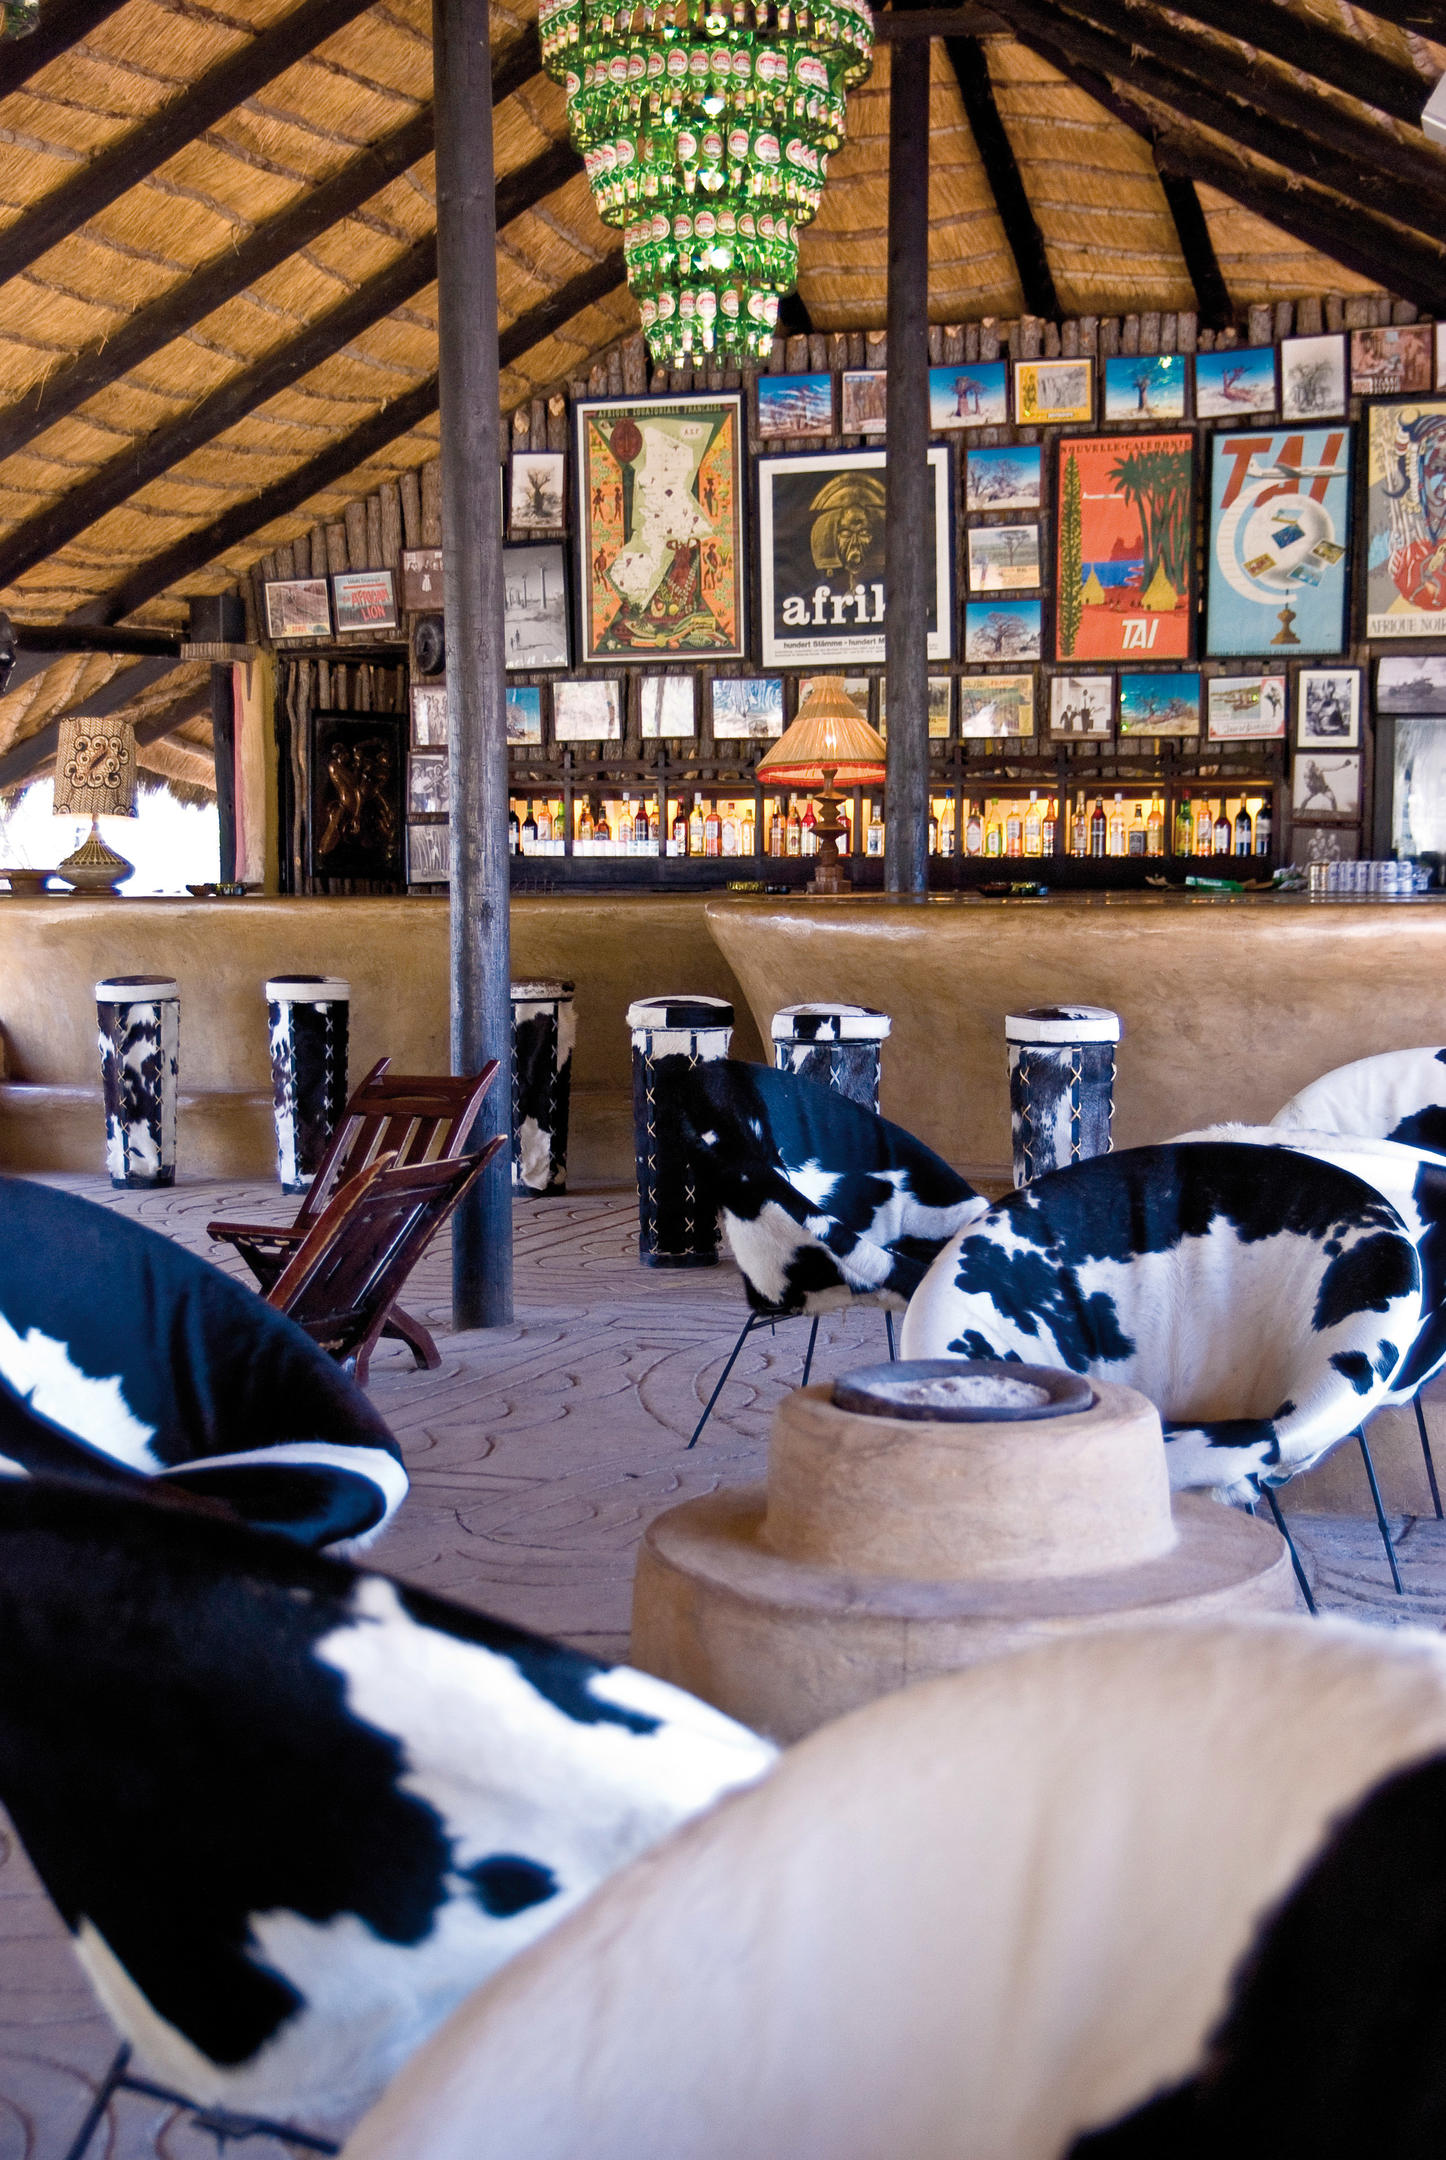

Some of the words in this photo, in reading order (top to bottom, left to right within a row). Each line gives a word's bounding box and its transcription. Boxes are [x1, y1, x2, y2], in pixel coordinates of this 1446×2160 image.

[1220, 432, 1344, 509] TAI
[361, 605, 386, 622] LION
[783, 640, 811, 649] hundert
[848, 638, 876, 646] hundert
[1121, 618, 1159, 650] TAI
